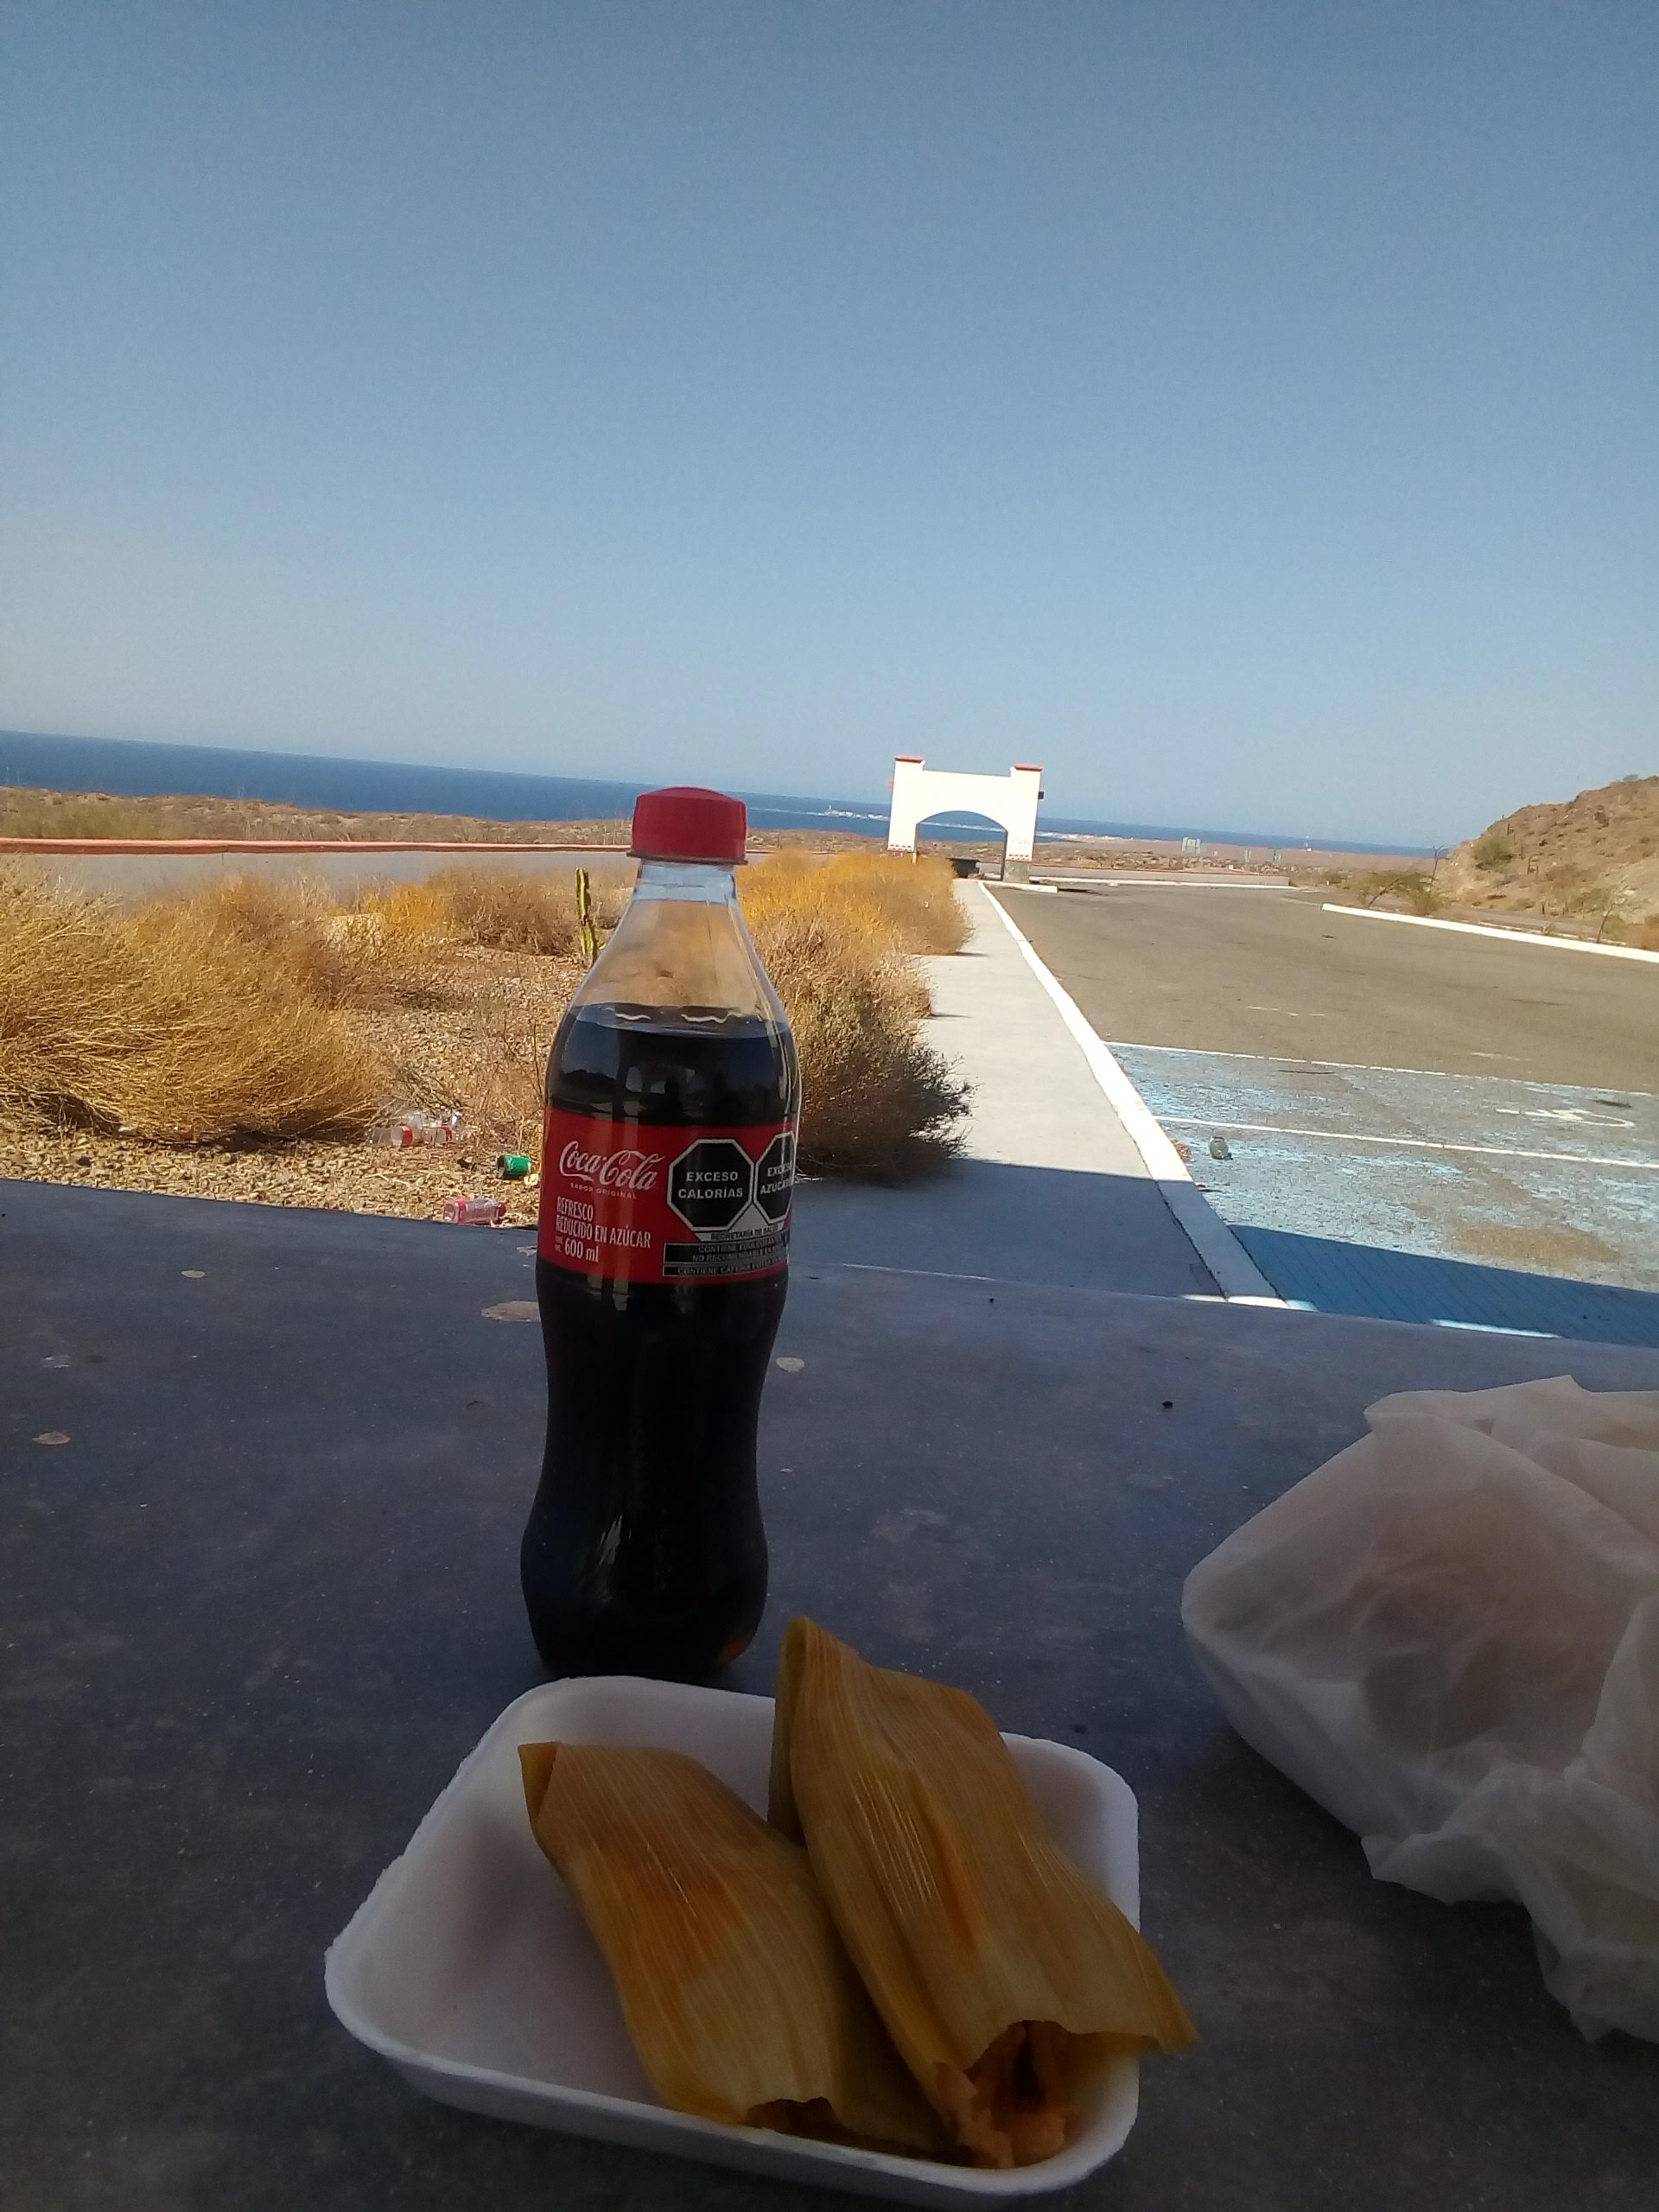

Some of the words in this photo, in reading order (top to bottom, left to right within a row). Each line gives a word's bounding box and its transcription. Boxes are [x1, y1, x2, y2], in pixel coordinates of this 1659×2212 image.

[559, 1141, 665, 1191] Coca-Cola
[686, 1171, 739, 1183] EXCESO
[595, 1187, 638, 1200] ORIGINAL
[677, 1185, 744, 1199] CALORÍAS
[556, 1196, 594, 1222] REFRESCO
[556, 1214, 594, 1241] REDUCIDO
[594, 1224, 608, 1244] EN
[609, 1224, 652, 1249] AZÚCAR
[564, 1237, 584, 1259] 600
[585, 1245, 599, 1263] ml
